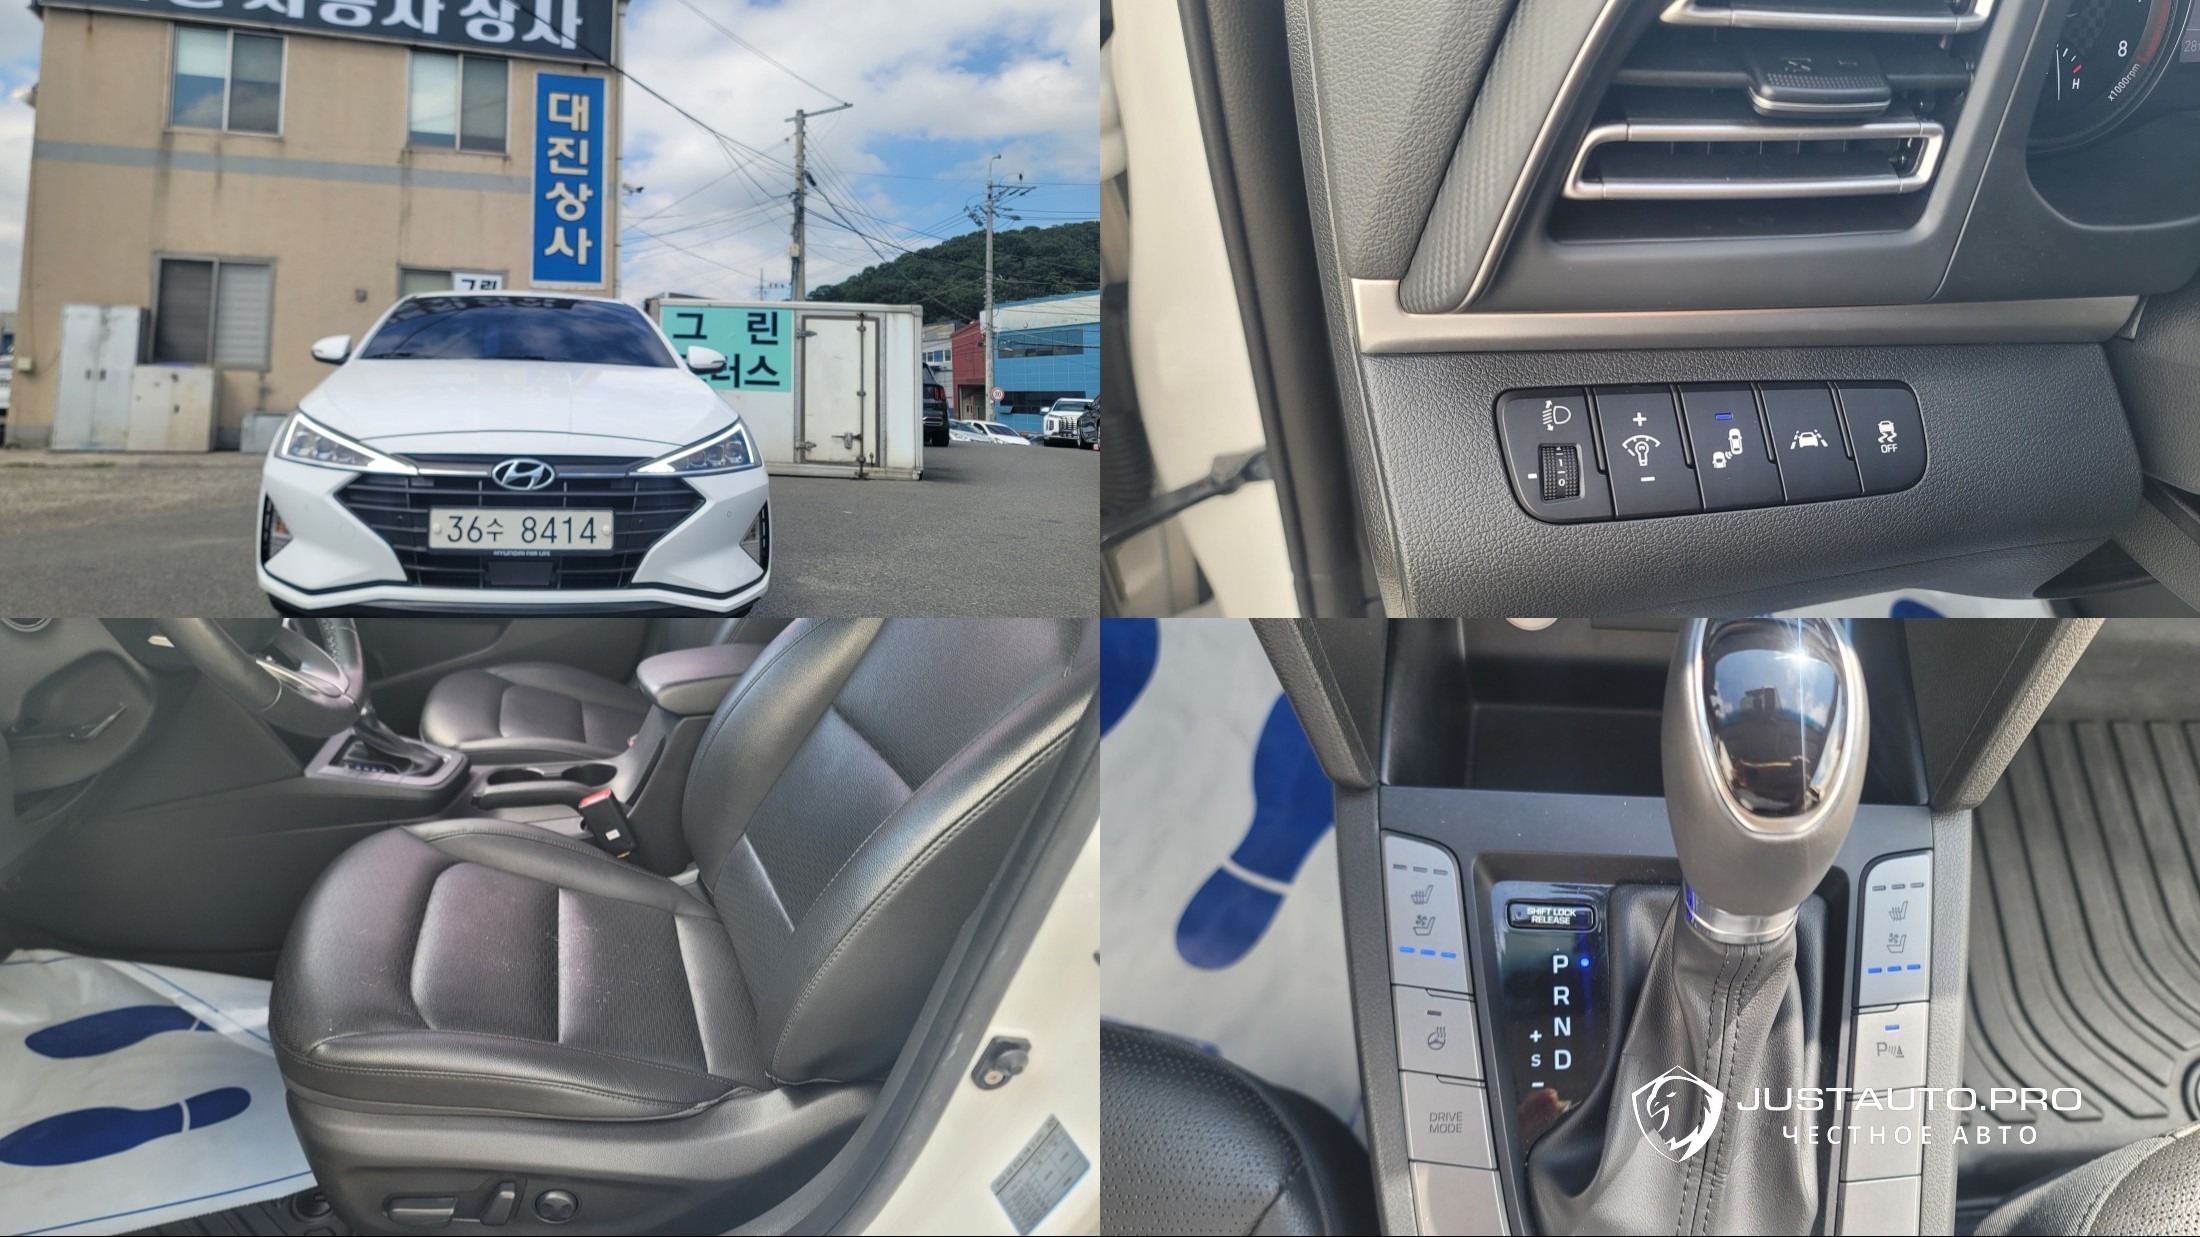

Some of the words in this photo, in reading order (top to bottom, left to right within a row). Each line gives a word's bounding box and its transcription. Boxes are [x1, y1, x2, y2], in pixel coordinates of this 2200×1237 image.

[2118, 40, 2128, 57] 8
[2184, 39, 2200, 53] 28
[2071, 78, 2080, 90] H
[2107, 63, 2141, 102] x1000rpm
[544, 92, 594, 265] 대진상사
[1880, 443, 1898, 454] OFF
[1558, 478, 1566, 487] 0
[447, 515, 504, 543] 36수
[521, 516, 597, 544] 8414
[1526, 906, 1552, 916] SHIFT
[1552, 907, 1577, 917] LOCK
[1531, 915, 1571, 925] RELEASE
[1552, 954, 1569, 974] P
[1553, 986, 1570, 1006] R
[1553, 1016, 1571, 1037] N
[1554, 1049, 1572, 1070] D
[1429, 1111, 1464, 1122] DRIVE
[1429, 1123, 1463, 1134] MODE
